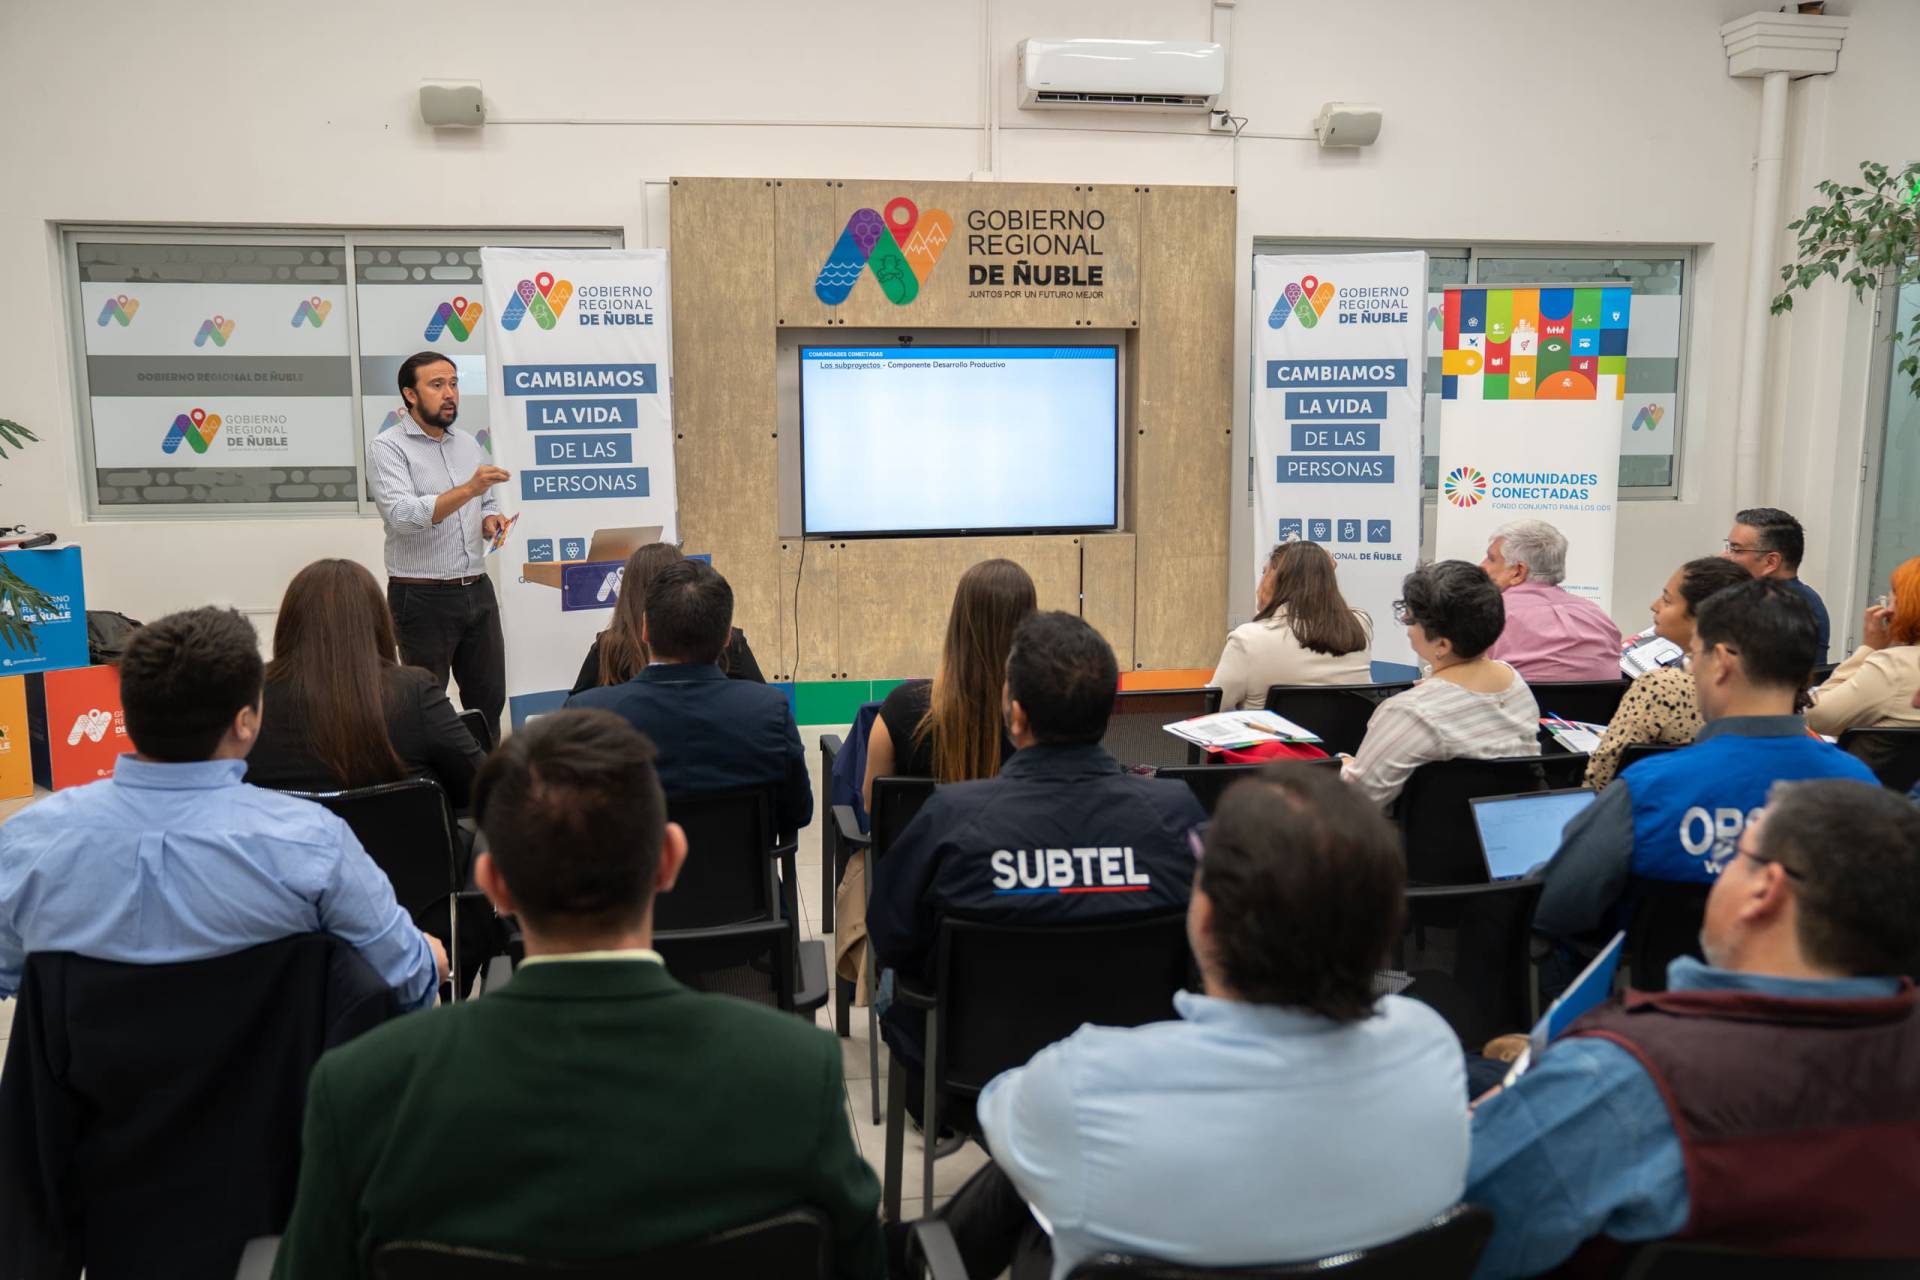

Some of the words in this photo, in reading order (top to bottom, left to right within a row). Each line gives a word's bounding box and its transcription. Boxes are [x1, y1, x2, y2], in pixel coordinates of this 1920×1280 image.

[968, 209, 1105, 231] GOBIERNO
[968, 234, 1104, 255] REGIONAL
[969, 264, 1005, 286] DE
[1013, 260, 1104, 286] ÑUBLE
[578, 286, 653, 298] GOBIERNO
[968, 290, 1003, 299] JUNTOS
[1004, 290, 1022, 298] POR
[1024, 291, 1037, 299] UN
[1038, 290, 1074, 299] FUTURO
[1075, 291, 1104, 299] MEJOR
[1339, 286, 1409, 298] GOBIERNO
[579, 299, 653, 310] REGIONAL
[1339, 299, 1408, 310] REGIONAL
[580, 314, 600, 326] DE
[603, 310, 654, 326] ÑUBLE
[1339, 313, 1358, 324] DE
[1361, 310, 1408, 324] ÑUBLE
[820, 361, 833, 369] Los
[834, 361, 881, 370] subproyectos
[887, 361, 931, 370] Componente
[136, 372, 195, 382] GOBIERNO
[197, 372, 253, 382] REGIONAL
[254, 372, 268, 382] DE
[515, 370, 645, 388] CAMBIAMOS
[1277, 365, 1396, 382] CAMBIAMOS
[1299, 399, 1323, 414] LA
[1326, 398, 1373, 414] VIDA
[225, 414, 288, 424] GOBIERNO
[542, 408, 568, 424] LA
[571, 407, 622, 424] VIDA
[226, 425, 288, 434] REGIONAL
[227, 437, 243, 446] DE
[247, 434, 288, 447] ÑUBLE
[1305, 431, 1328, 446] DE
[1334, 431, 1366, 445] LAS
[550, 443, 577, 459] DE
[583, 441, 617, 458] LAS
[1288, 461, 1383, 477] PERSONAS
[533, 474, 637, 493] PERSONAS
[1492, 472, 1598, 486] COMUNIDADES
[1492, 487, 1589, 500] CONECTADAS
[1492, 502, 1517, 510] FONDO
[1518, 503, 1558, 511] CONJUNTO
[1360, 552, 1371, 560] DE
[1373, 551, 1402, 560] ÑUBLE
[991, 847, 1151, 890] SUBTEL
